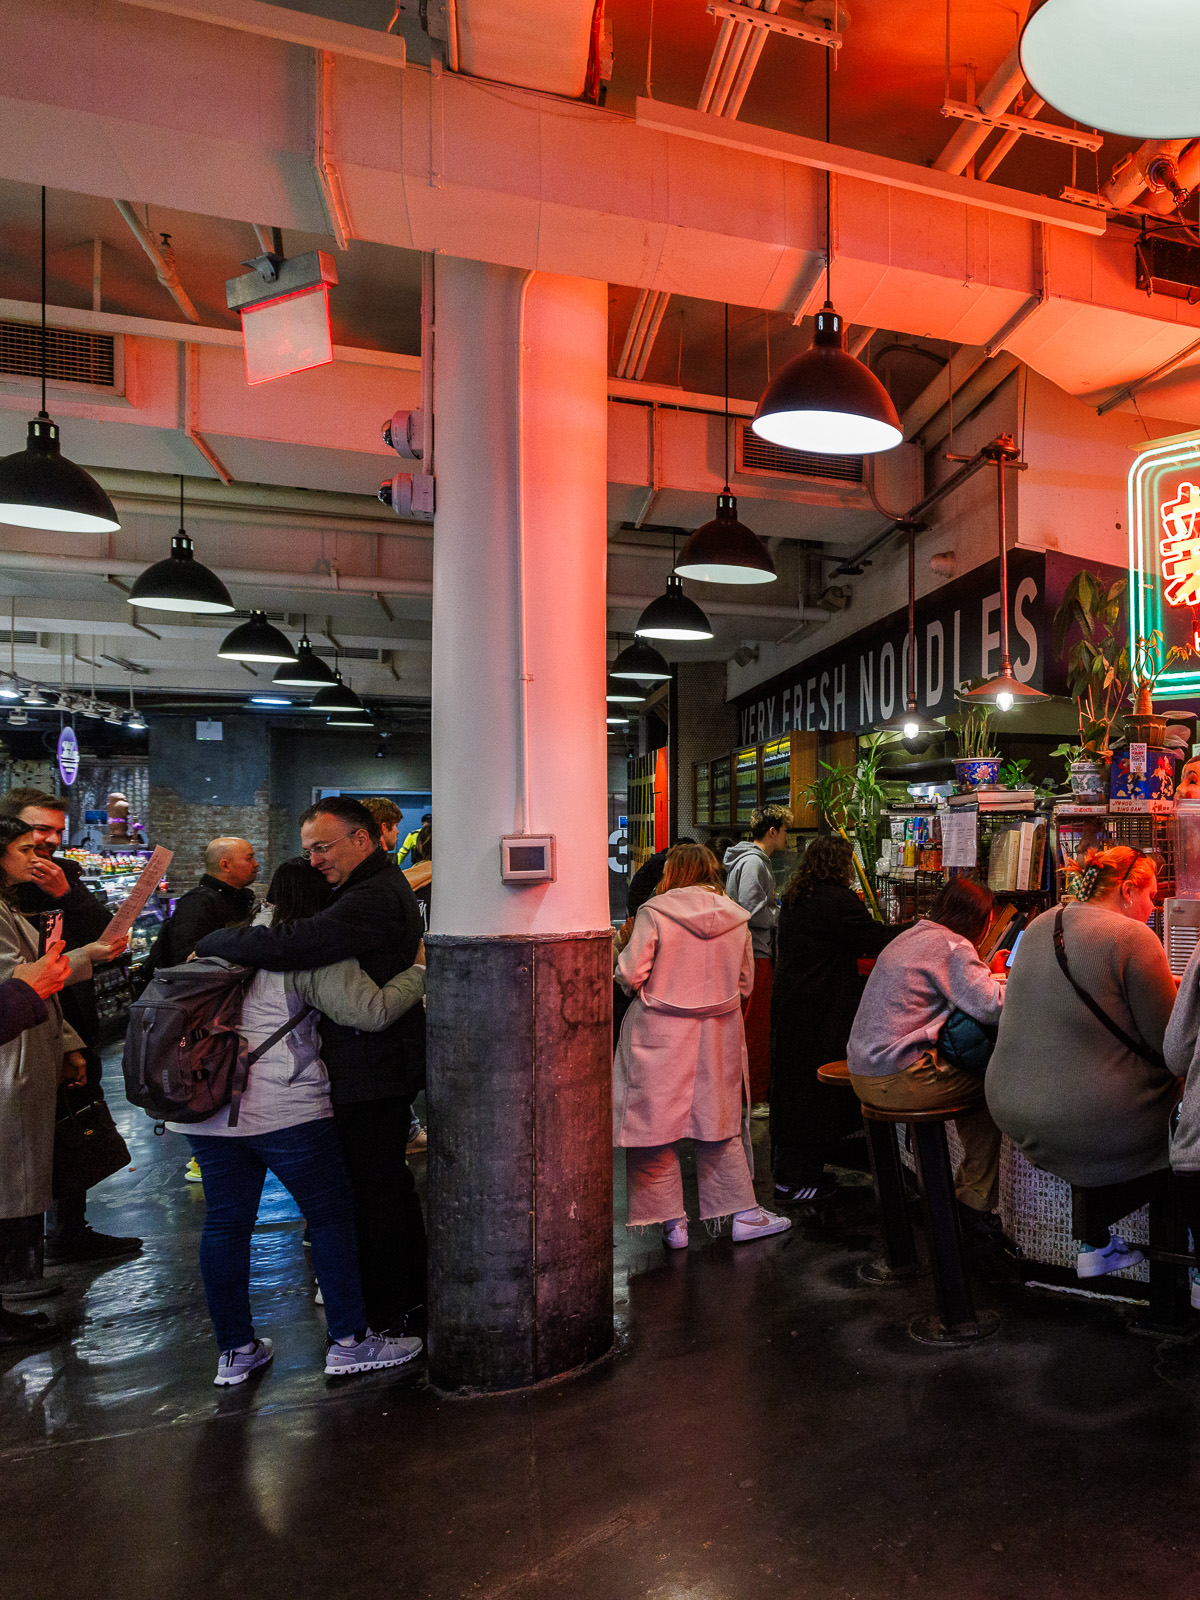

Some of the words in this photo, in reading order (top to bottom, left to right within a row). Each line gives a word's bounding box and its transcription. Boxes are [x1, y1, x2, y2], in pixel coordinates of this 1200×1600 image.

[740, 694, 776, 747] VERY
[781, 663, 847, 733] FRESH
[859, 577, 1039, 726] NOODLES
